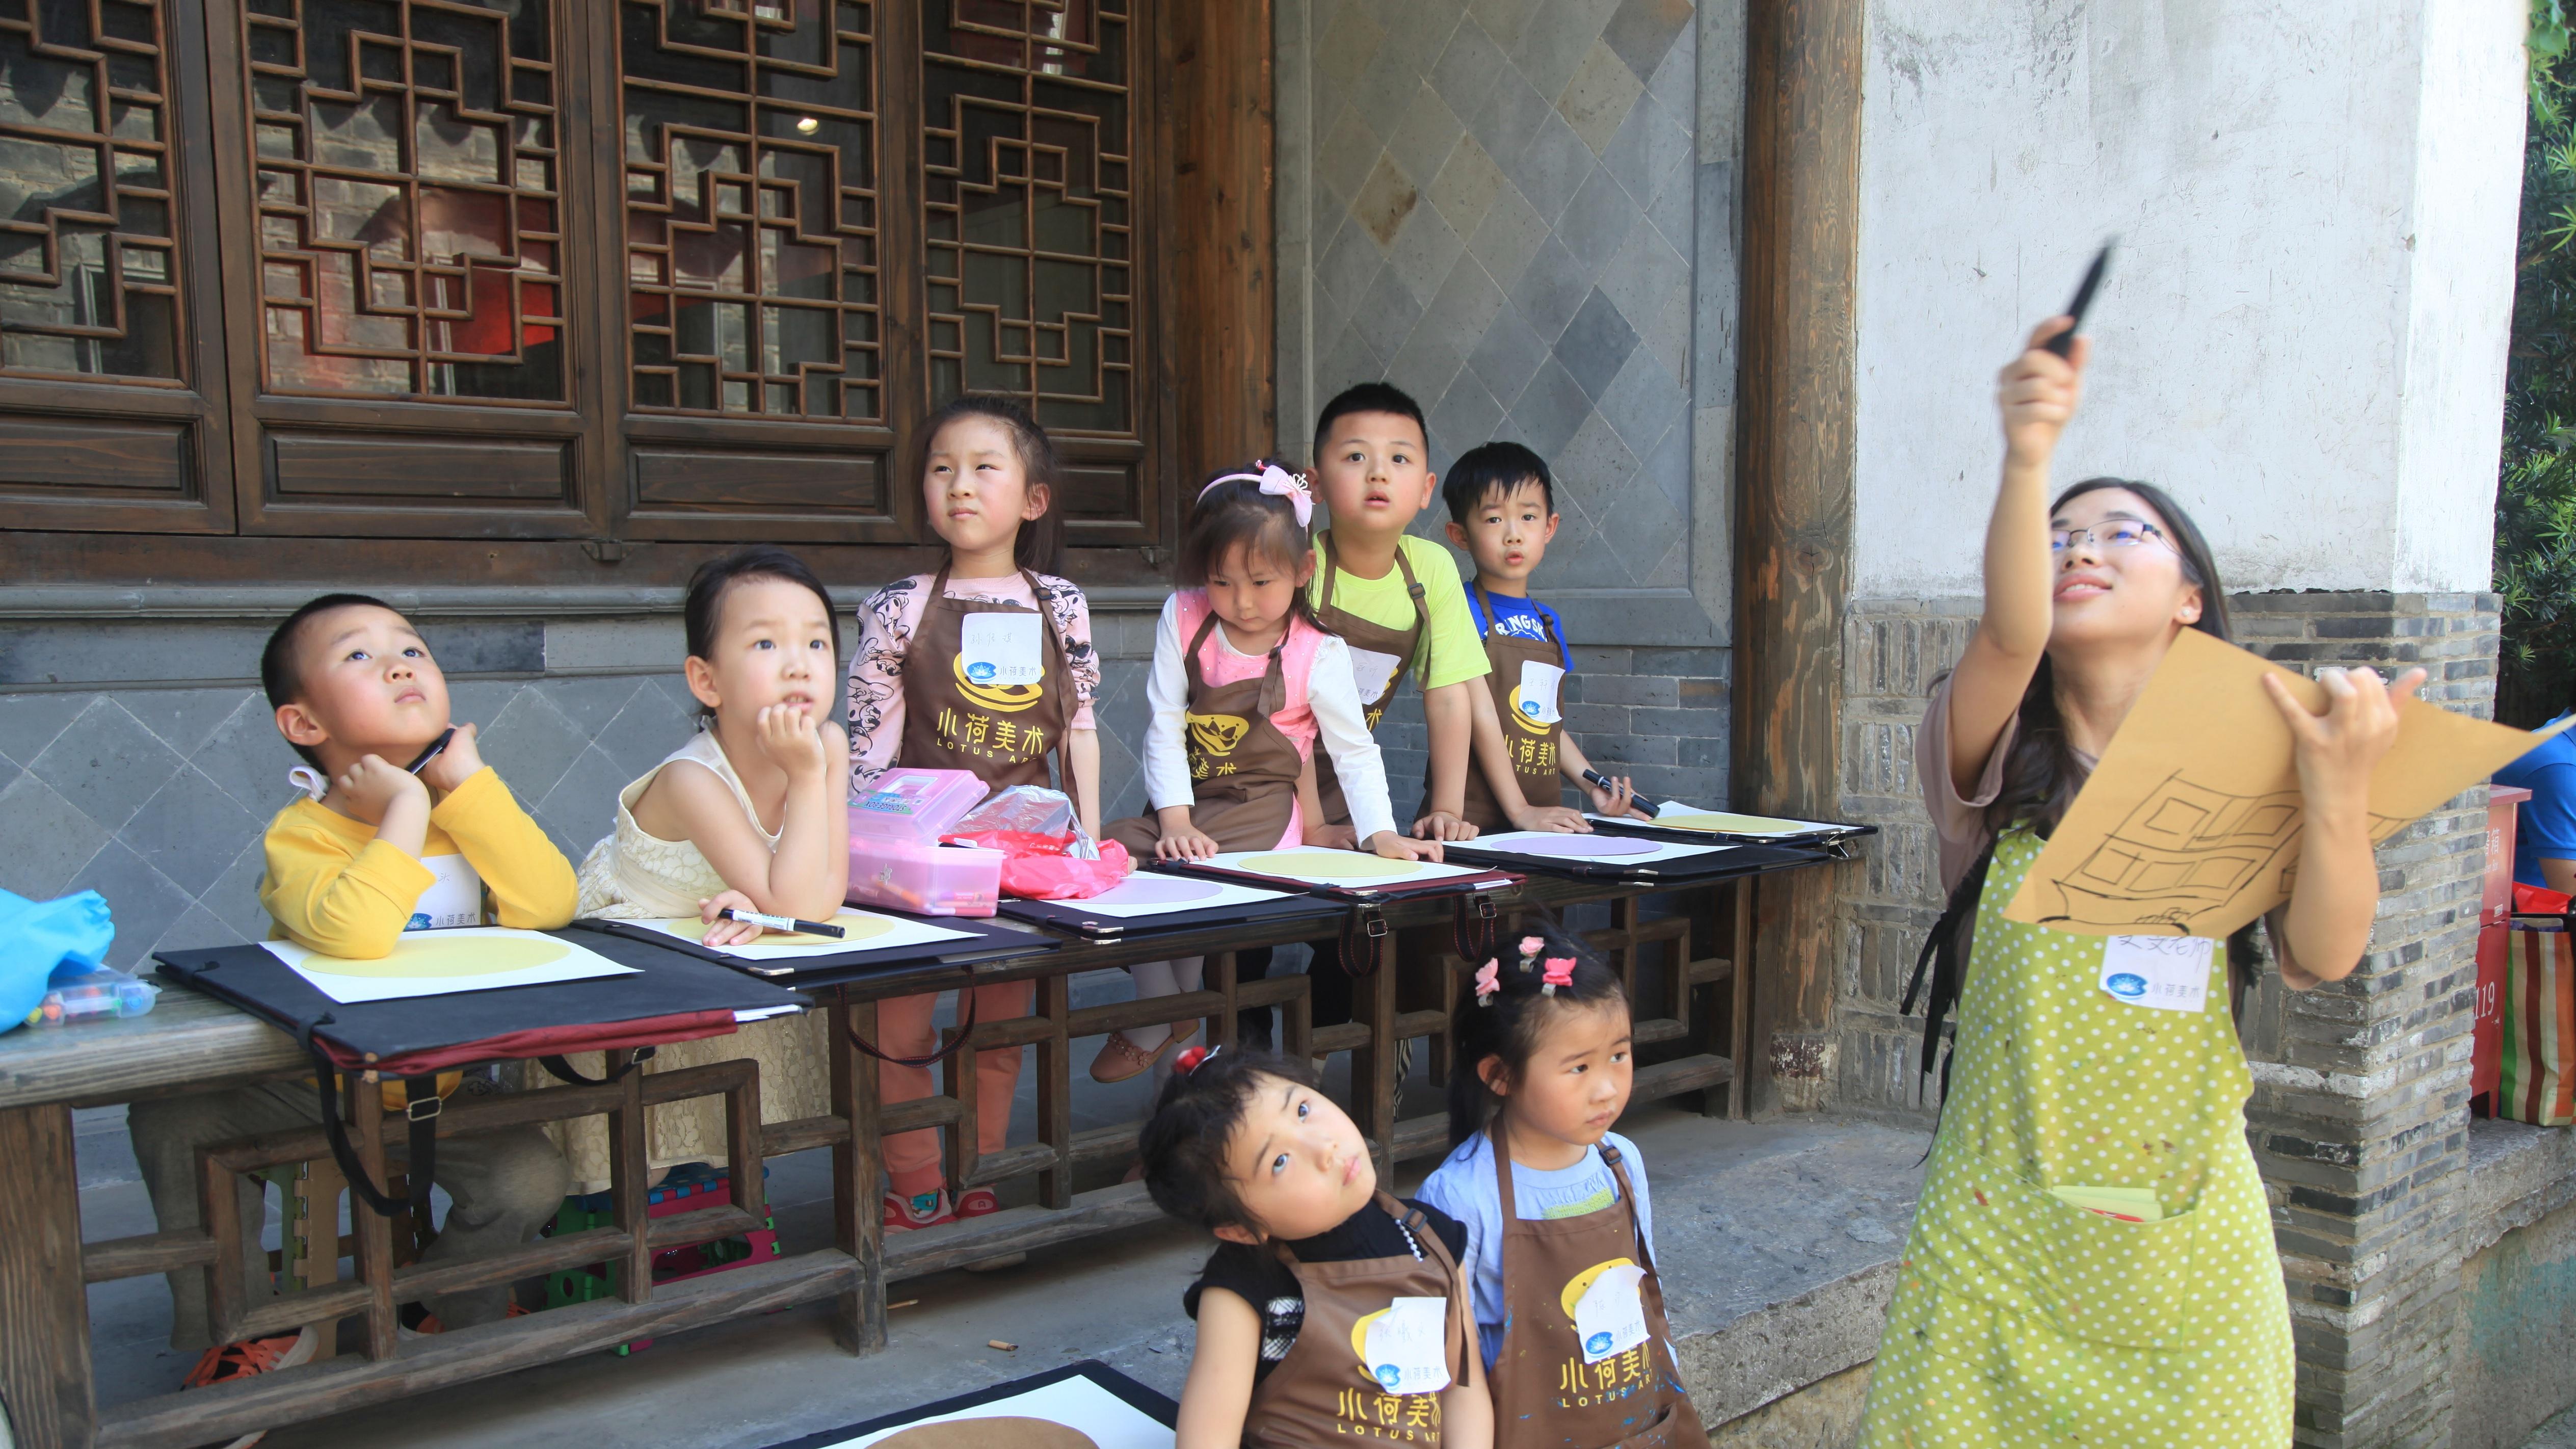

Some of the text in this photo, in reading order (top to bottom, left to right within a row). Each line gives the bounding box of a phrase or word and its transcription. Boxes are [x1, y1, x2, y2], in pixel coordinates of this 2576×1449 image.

[999, 666, 1037, 677] 小荷美术
[936, 707, 1044, 755] 小荷美术
[937, 737, 994, 758] LOTUS
[1516, 764, 1537, 775] TUS
[436, 912, 476, 926] 小荷美术
[2151, 983, 2200, 998] 小荷美术
[2475, 982, 2495, 1020] 119
[1616, 1320, 1642, 1342] 小荷美术
[1404, 1366, 1443, 1380] 小荷美术
[1337, 1424, 1415, 1441] LOTUS
